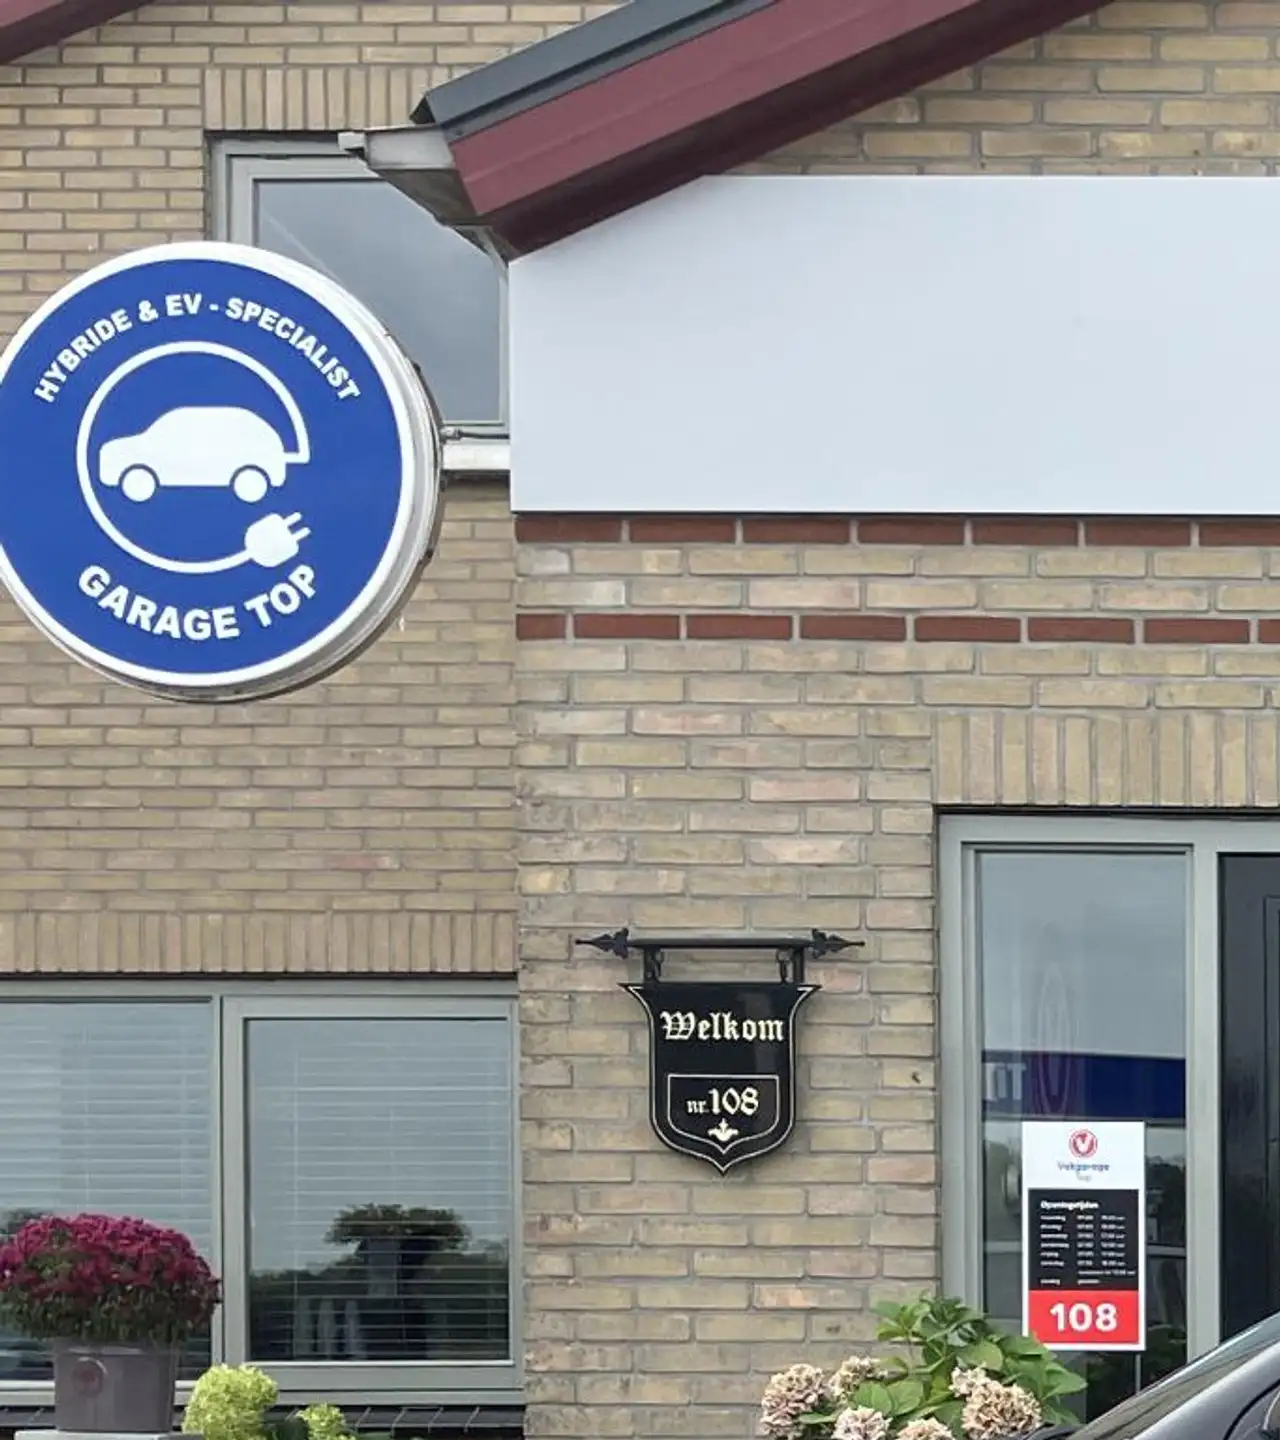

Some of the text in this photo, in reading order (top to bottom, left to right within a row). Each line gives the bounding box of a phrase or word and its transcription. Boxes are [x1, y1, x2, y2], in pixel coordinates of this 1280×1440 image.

[33, 308, 134, 403] HYBRIDE
[138, 300, 159, 323] &
[166, 293, 203, 316] EV
[224, 297, 362, 402] SPECIALIST
[78, 564, 317, 641] GARAGE TOP
[659, 1010, 784, 1042] Welkom
[1050, 1303, 1118, 1332] 108
